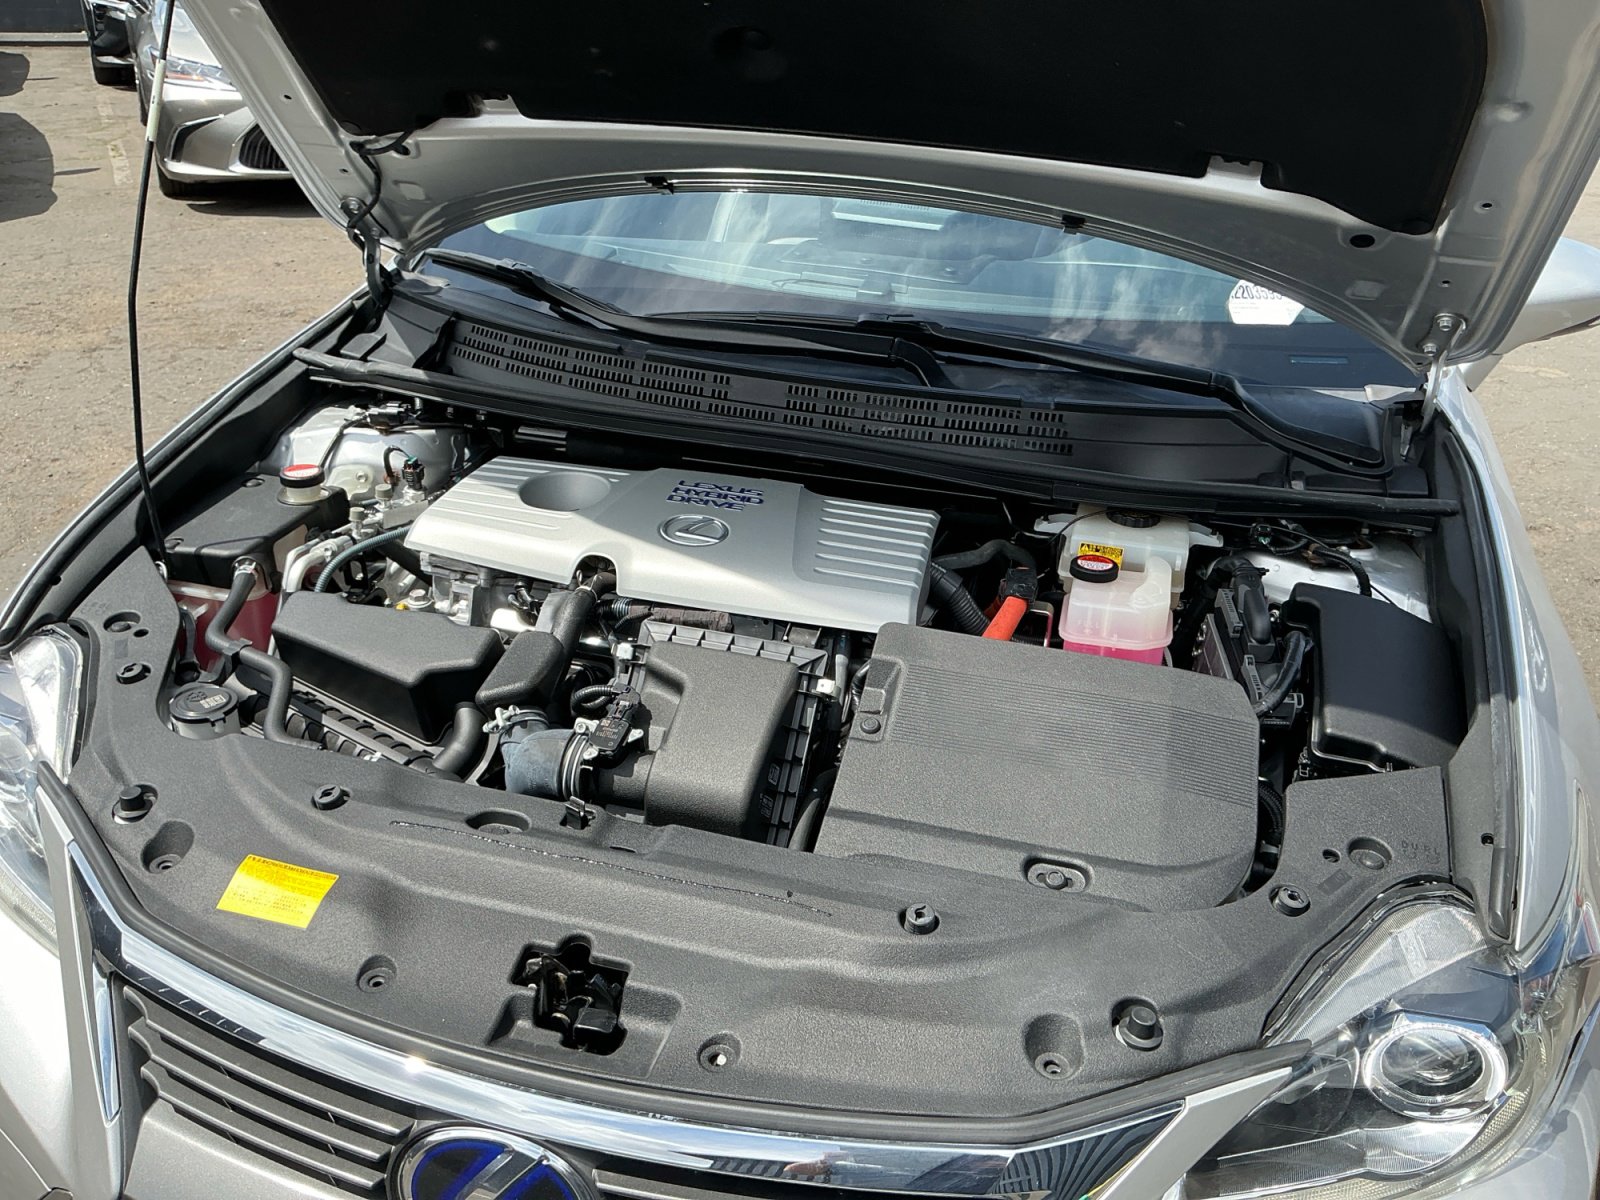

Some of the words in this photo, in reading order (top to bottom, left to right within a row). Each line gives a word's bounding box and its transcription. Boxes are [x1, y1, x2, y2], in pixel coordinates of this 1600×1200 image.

[672, 487, 764, 505] HYBRID
[678, 480, 764, 496] LEXUS
[666, 494, 746, 511] DRIVE
